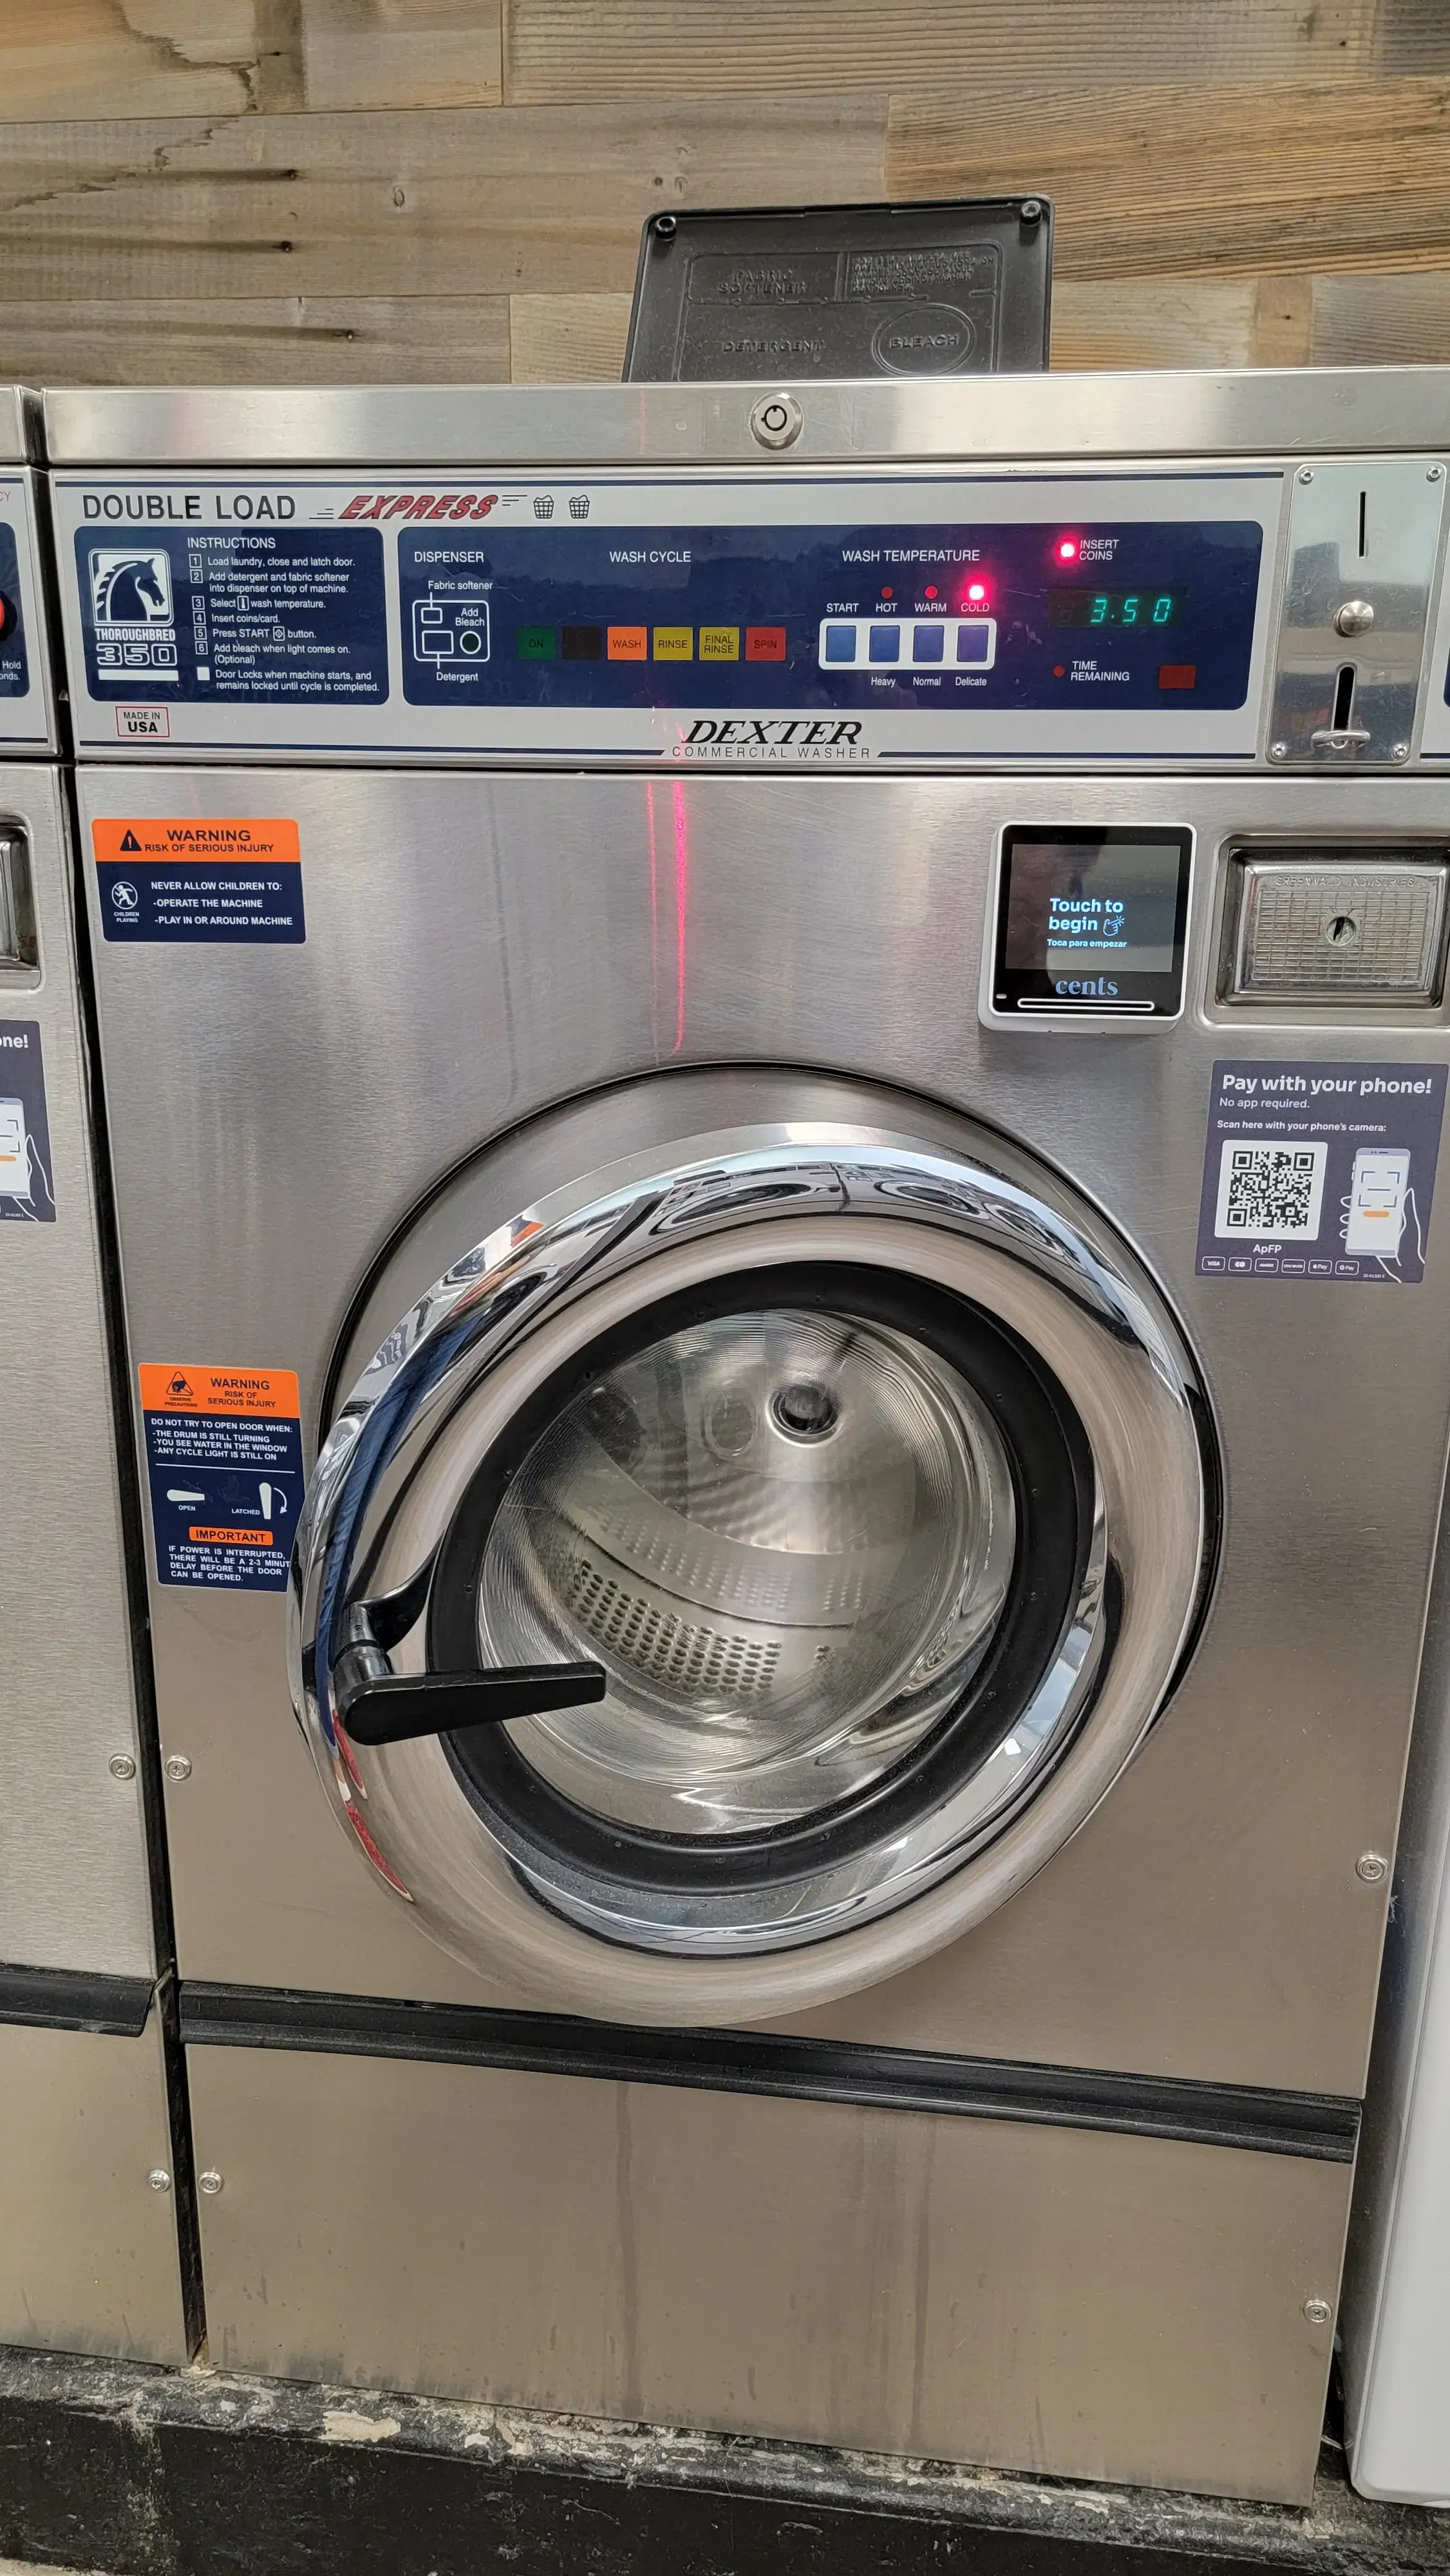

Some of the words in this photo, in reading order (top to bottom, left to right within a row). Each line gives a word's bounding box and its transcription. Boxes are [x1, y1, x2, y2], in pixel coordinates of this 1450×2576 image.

[722, 339, 824, 352] DETERGENT
[889, 334, 959, 348] BLEACH
[82, 495, 202, 519] DOUBLE
[216, 495, 295, 519] LOAD
[338, 495, 498, 520] EXPRESS
[187, 537, 275, 548] INSTRUCTIONS
[1080, 539, 1119, 549] INSERT
[414, 551, 484, 562] DISPENSER
[609, 551, 645, 562] WASH
[649, 551, 690, 562] CYCLE
[842, 550, 880, 562] WASH
[883, 549, 979, 561] TEMPERATURE
[1078, 551, 1112, 560] COINS
[207, 556, 229, 565] Load
[231, 556, 265, 567] laundry,
[267, 556, 289, 565] close
[292, 557, 308, 565] and
[310, 556, 330, 565] latch
[333, 556, 355, 566] door.
[209, 571, 225, 580] Add
[227, 572, 268, 583] detergent
[270, 572, 286, 581] and
[288, 572, 312, 581] fabric
[314, 572, 349, 581] softener
[209, 583, 225, 592] into
[227, 583, 268, 594] dispenser
[283, 584, 297, 594] top
[299, 584, 307, 592] of
[310, 584, 348, 592] machine.
[428, 580, 455, 589] Fabric
[457, 580, 493, 589] softener
[211, 598, 236, 607] Select
[250, 598, 272, 607] wash
[274, 599, 325, 609] temperature.
[827, 603, 858, 612] START
[876, 603, 897, 612] HOT
[914, 603, 946, 612] WARM
[961, 603, 989, 612] COLD
[461, 607, 478, 616] Add
[211, 613, 234, 622] Insert
[236, 614, 280, 623] coins/card.
[455, 617, 484, 626] Bleach
[94, 627, 175, 641] THOROUGHBRED
[212, 628, 236, 637] Press
[239, 629, 269, 638] START
[287, 629, 316, 638] button.
[612, 639, 641, 648] WASH
[658, 639, 687, 648] RINSE
[705, 635, 733, 643] FINAL
[752, 639, 777, 649] SPIN
[213, 643, 230, 652] Add
[232, 643, 260, 652] bleach
[262, 643, 285, 652] when
[287, 644, 305, 655] light
[704, 644, 733, 653] RINSE
[96, 643, 177, 666] 350
[214, 654, 255, 665] (Optional)
[2, 660, 21, 669] Hold
[1072, 661, 1097, 670] TIME
[215, 669, 236, 678] Door
[238, 669, 262, 678] Locks
[264, 670, 287, 679] when
[289, 670, 325, 679] machine
[327, 671, 352, 681] starts,
[355, 671, 371, 679] and
[436, 672, 478, 683] Detergent
[912, 676, 941, 685] Normal
[955, 676, 986, 685] Delicate
[1071, 671, 1129, 681] REMAINING
[871, 676, 896, 688] Heavy
[127, 721, 158, 732] USA
[681, 721, 863, 744] DEXTER
[672, 746, 787, 757] COMMERCIAL
[797, 747, 869, 758] WASHER
[166, 829, 250, 841] WARNING
[151, 881, 182, 889] NEVER
[218, 882, 265, 890] CHILDREN
[266, 882, 281, 890] TO:
[221, 899, 263, 907] MACHINE
[1050, 898, 1100, 912] Touch
[1104, 899, 1123, 913] to
[194, 916, 208, 924] OR
[209, 916, 249, 924] AROUND
[250, 916, 292, 925] MACHINE
[1048, 916, 1097, 933] begin
[1055, 976, 1118, 996] cents
[1223, 1074, 1257, 1094] Pay
[1261, 1075, 1306, 1090] with
[1310, 1079, 1357, 1095] your
[1360, 1077, 1431, 1095] phone!
[1219, 1097, 1234, 1106] No
[1237, 1099, 1257, 1109] app
[1261, 1098, 1310, 1110] required.
[1217, 1119, 1239, 1128] Scan
[1242, 1120, 1263, 1128] here
[1265, 1121, 1285, 1129] with
[1287, 1122, 1308, 1131] your
[1310, 1122, 1346, 1132] phone's
[1252, 1244, 1281, 1255] ApFP
[210, 1378, 269, 1390] WARNING
[207, 1397, 243, 1406] SERIOUS
[265, 1424, 292, 1432] WHEN:
[196, 1530, 265, 1542] IMPORTANT
[180, 1546, 210, 1554] POWER
[226, 1548, 285, 1559] INTERRUPTED,
[200, 1564, 233, 1572] BEFORE
[258, 1567, 281, 1575] DOOR
[207, 1572, 243, 1581] OPENED.
